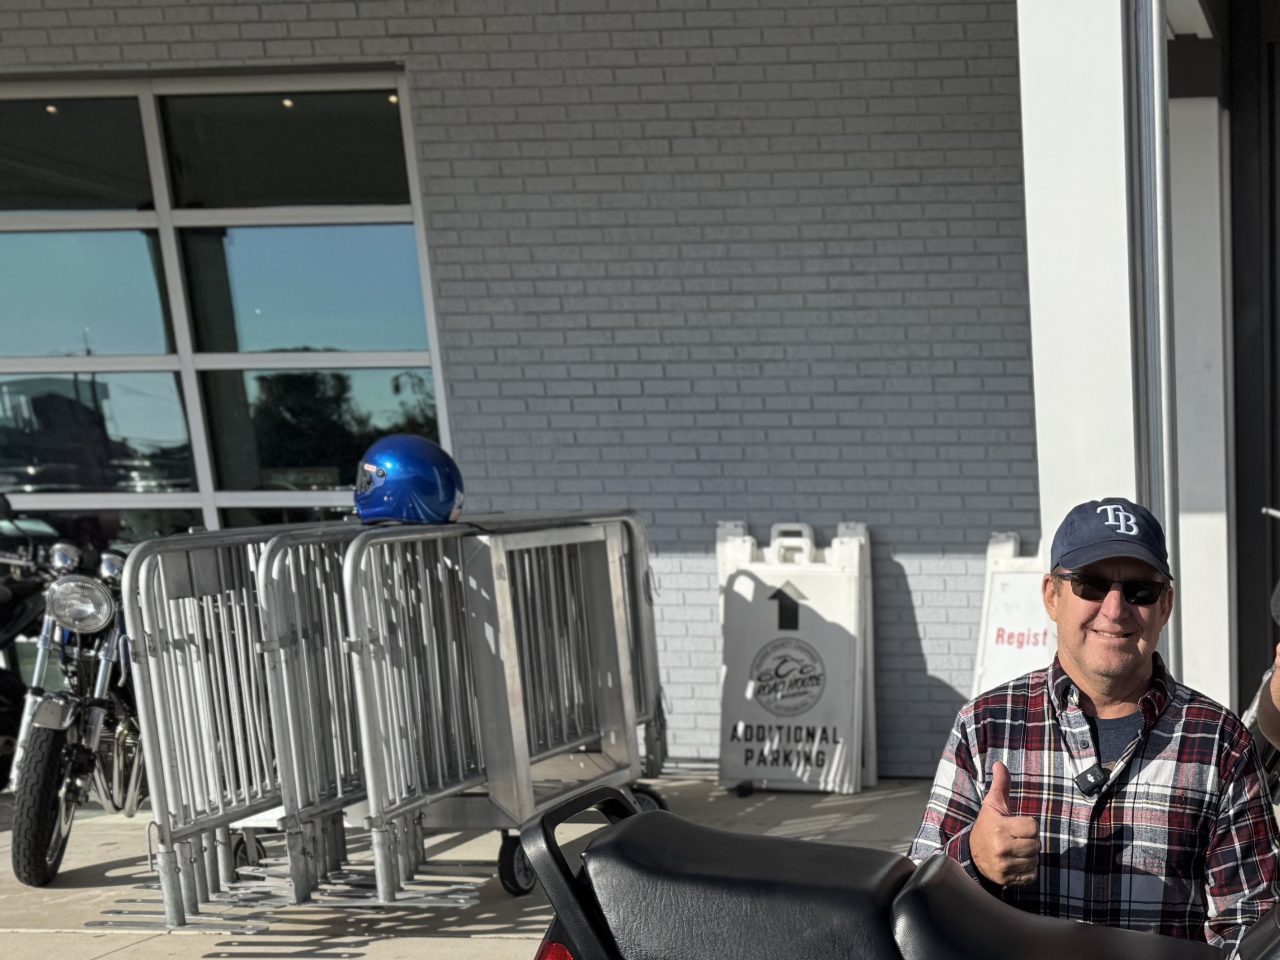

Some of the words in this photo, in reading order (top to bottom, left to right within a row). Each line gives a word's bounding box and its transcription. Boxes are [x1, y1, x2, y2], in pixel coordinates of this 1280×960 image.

[1096, 504, 1139, 536] TB
[756, 680, 787, 697] ROAD
[786, 672, 824, 691] HOUSE
[730, 724, 841, 745] ADDITIONAL
[744, 748, 826, 769] PARKING
